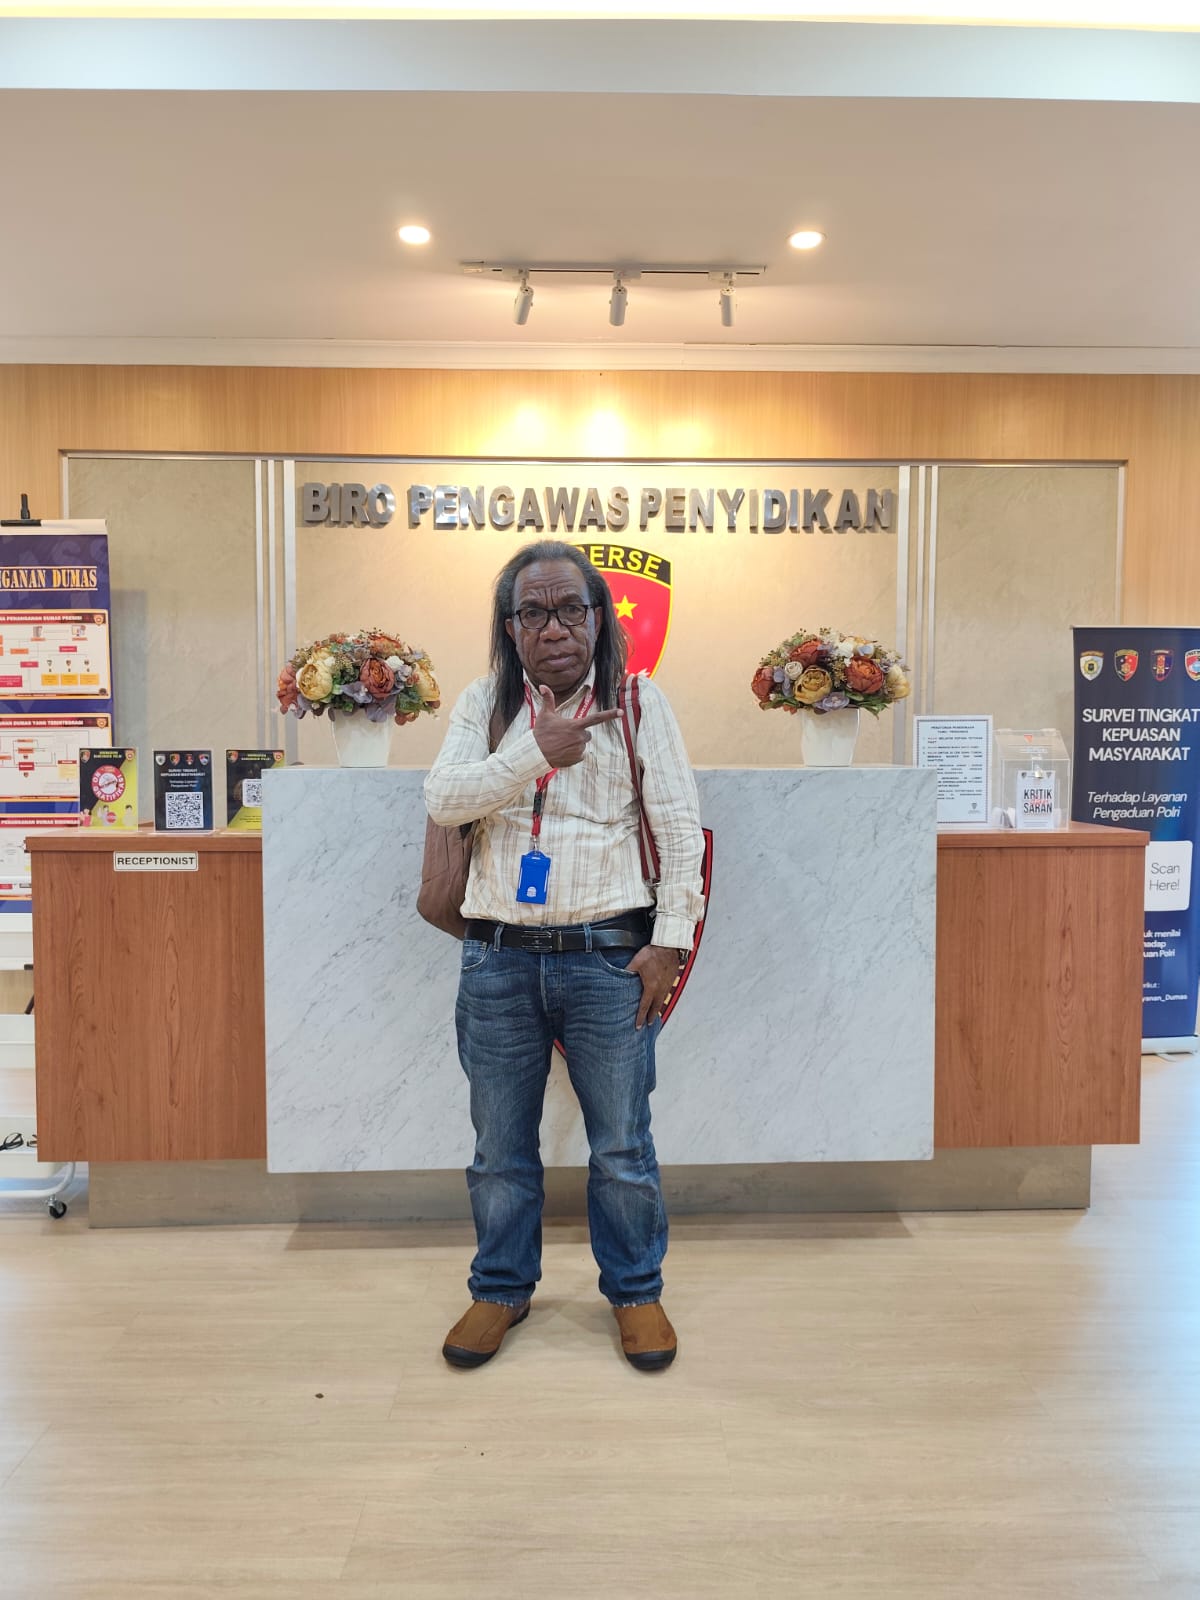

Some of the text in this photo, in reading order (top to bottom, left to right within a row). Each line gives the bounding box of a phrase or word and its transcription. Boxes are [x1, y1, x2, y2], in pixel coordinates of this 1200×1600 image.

[303, 482, 894, 532] BIRO PENGAWAS PENYIDIKAN
[52, 568, 98, 588] DUMAS
[1082, 708, 1200, 722] SURVEI TINGKAT
[1102, 728, 1181, 742] KEPUASAN
[1088, 746, 1191, 761] MASYARAKAT
[1023, 789, 1052, 800] KRITIK
[1088, 791, 1188, 805] Terhadap Layanan
[1023, 802, 1053, 813] SARAN
[1093, 806, 1181, 821] Pengaduan Polri
[117, 857, 195, 865] RECEPTIONIST
[1151, 862, 1180, 875] Scan
[1149, 880, 1180, 891] Here!
[1154, 929, 1181, 938] menilai
[1160, 949, 1176, 957] Polri
